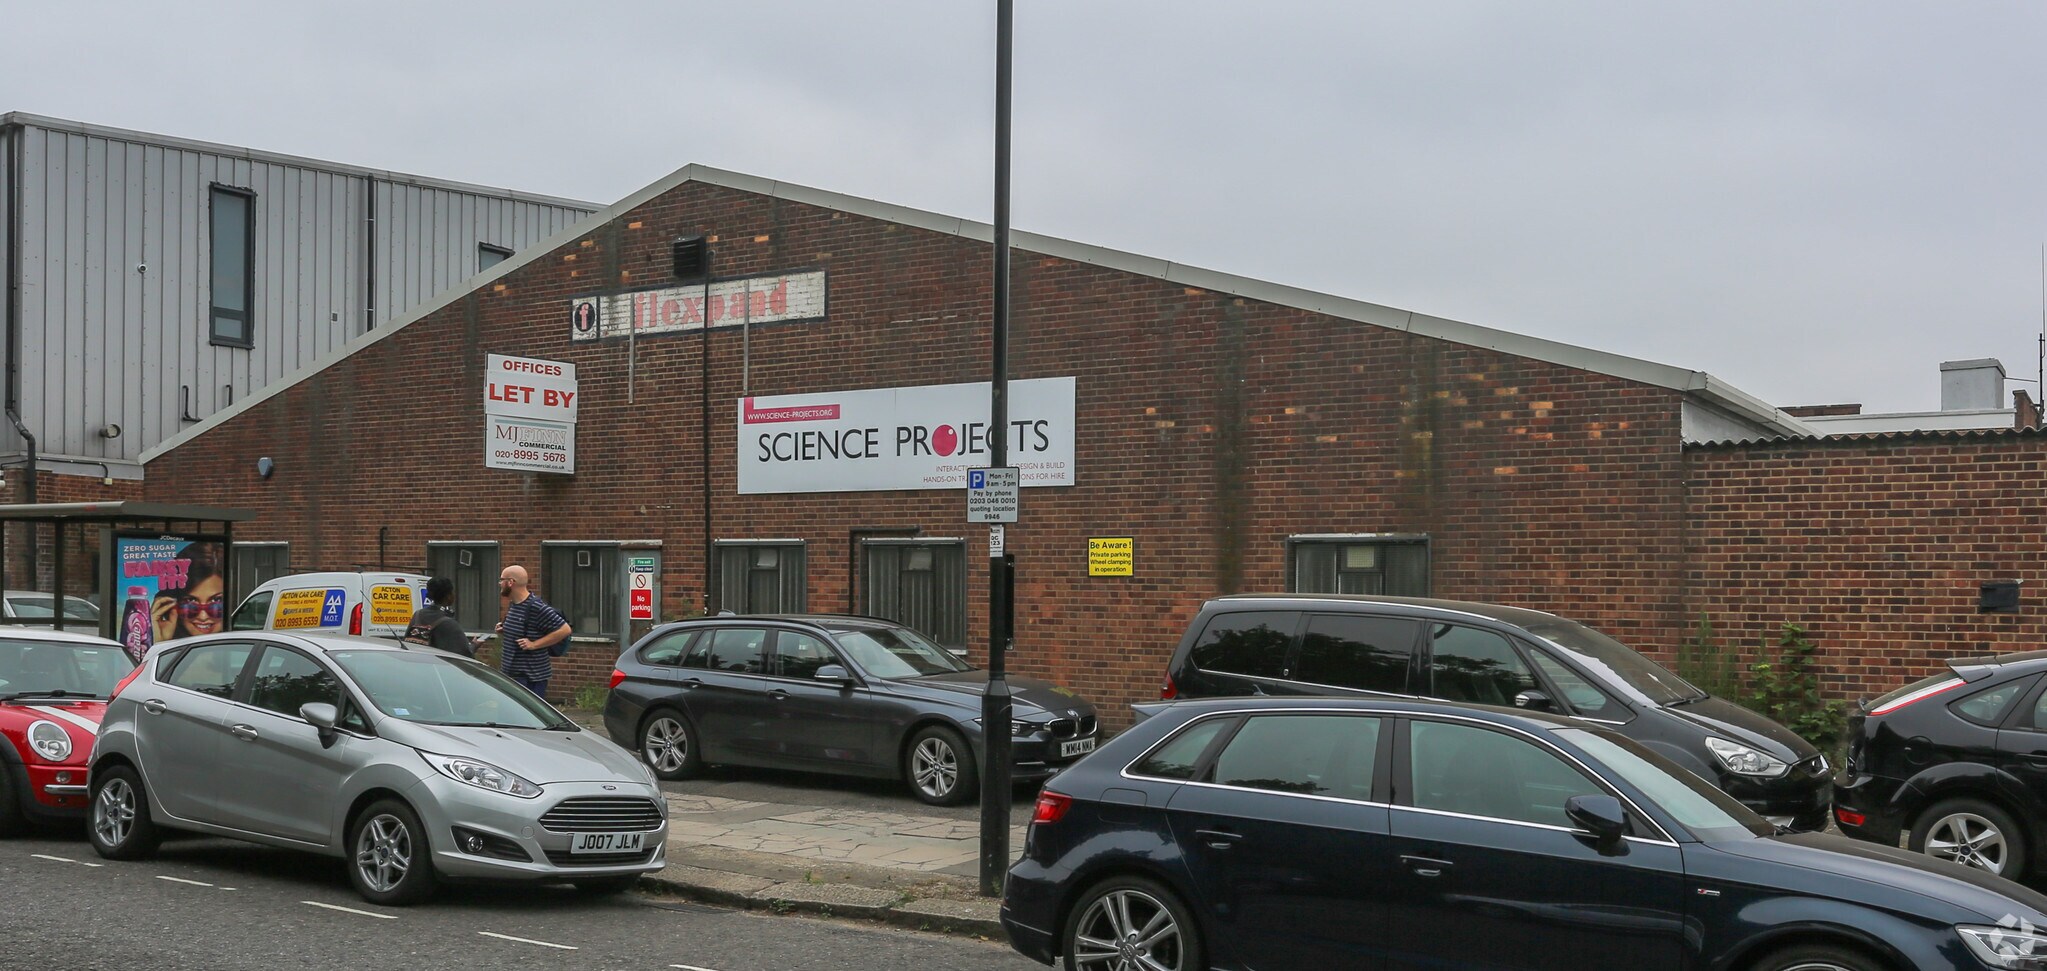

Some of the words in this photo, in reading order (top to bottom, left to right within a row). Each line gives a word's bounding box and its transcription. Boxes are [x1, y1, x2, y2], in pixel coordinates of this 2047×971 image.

[503, 360, 562, 376] OFFICES
[489, 383, 535, 404] LET
[544, 389, 575, 409] BY
[747, 409, 833, 420] WWW.SCIENCE-PROJECTS.ORG
[519, 442, 566, 451] COMMERCIAL
[758, 428, 879, 463] SCIENCE
[543, 452, 566, 463] 5678
[495, 461, 565, 469] www.mjfinncommercial.co.uk
[1037, 472, 1049, 480] FOR
[1050, 472, 1065, 480] HIRE
[1090, 541, 1100, 549] Be
[310, 590, 325, 598] CARE
[390, 593, 410, 601] CARE
[631, 604, 651, 613] parking
[275, 618, 287, 627] 020
[287, 617, 303, 627] 8993
[303, 616, 319, 626] 6539
[615, 834, 641, 849] JLM
